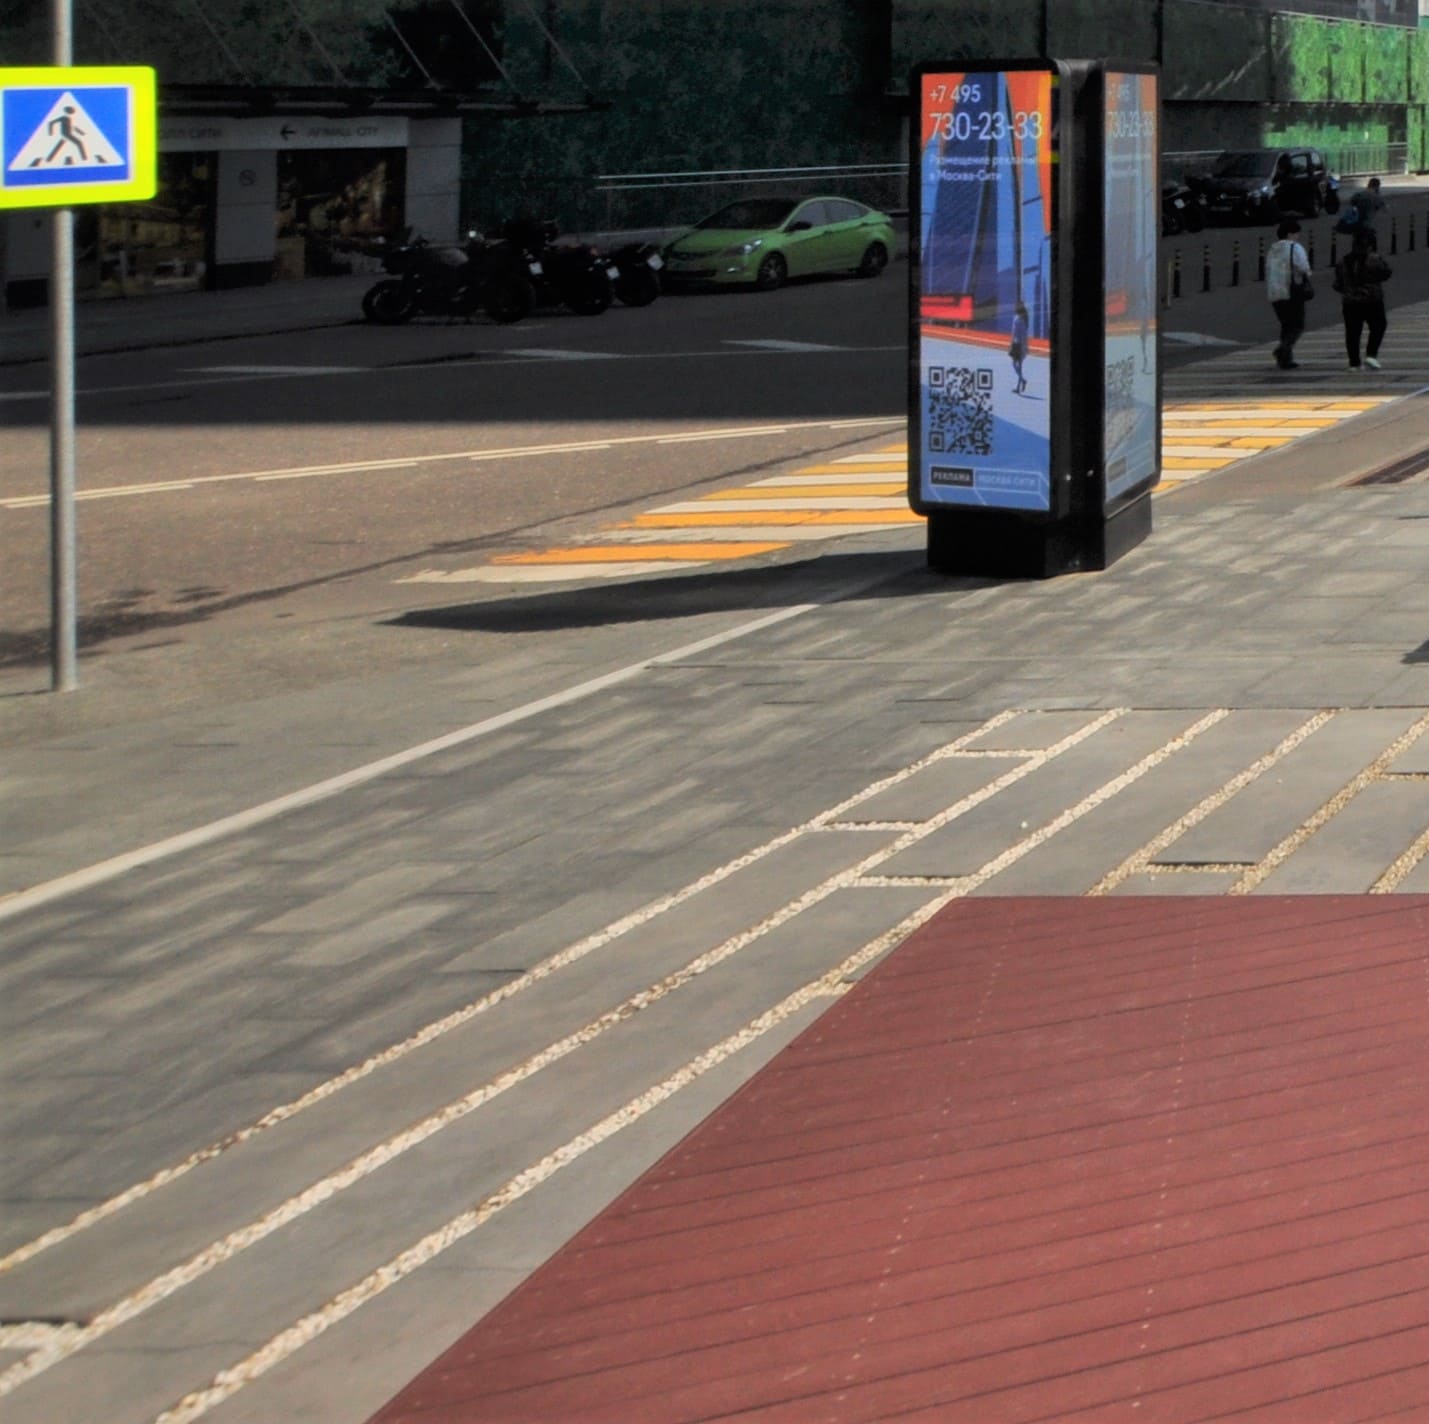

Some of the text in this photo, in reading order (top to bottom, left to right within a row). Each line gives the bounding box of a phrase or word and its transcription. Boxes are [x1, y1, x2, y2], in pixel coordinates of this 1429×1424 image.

[929, 83, 982, 104] +7 495
[928, 110, 1043, 141] 730-23-33
[936, 169, 1003, 182] Москва-Сити
